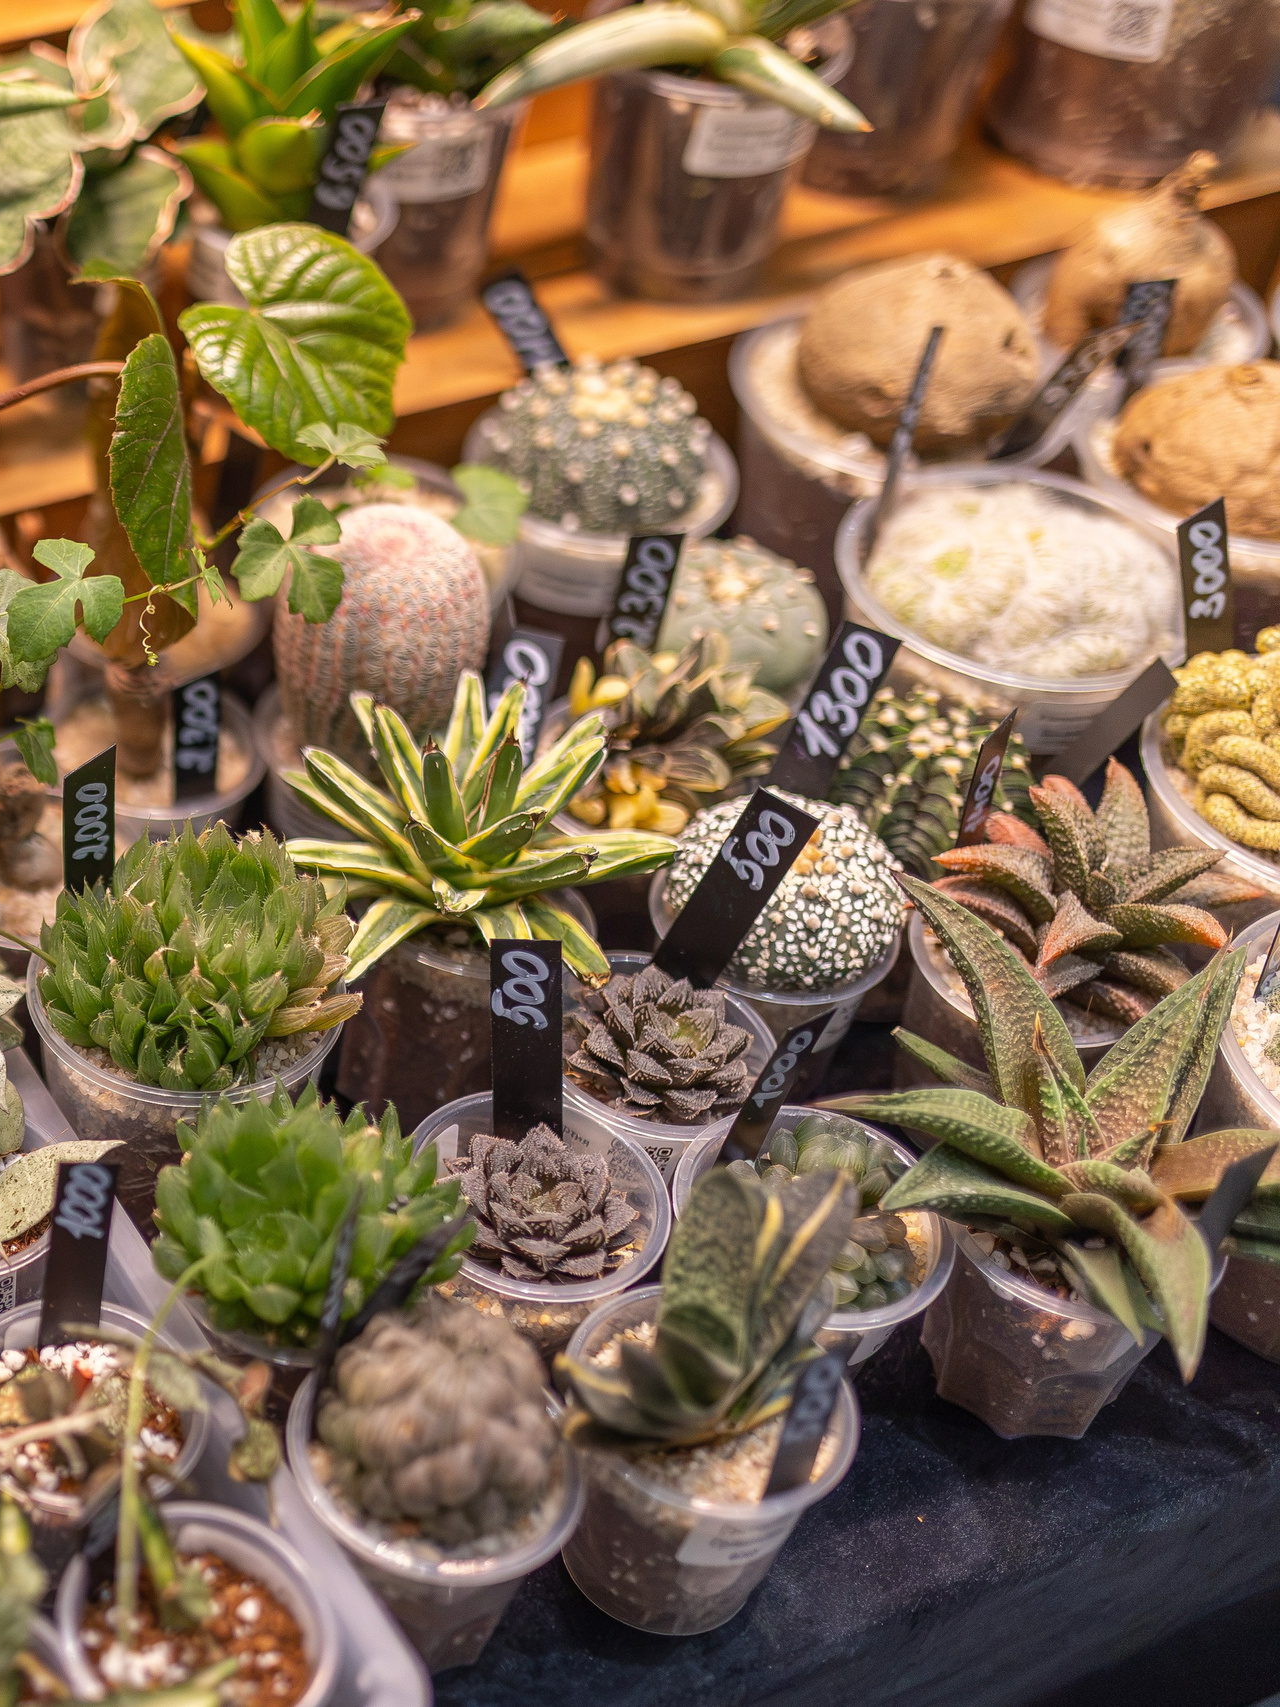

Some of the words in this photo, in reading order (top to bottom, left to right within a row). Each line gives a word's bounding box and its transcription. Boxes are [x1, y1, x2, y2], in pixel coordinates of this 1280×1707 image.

[1189, 520, 1226, 619] 3000
[797, 631, 883, 757] 1300
[73, 782, 110, 860] 2000
[721, 809, 796, 891] 500
[491, 951, 549, 1030] 500
[751, 1030, 813, 1108] 1000
[54, 1163, 112, 1240] 1000
